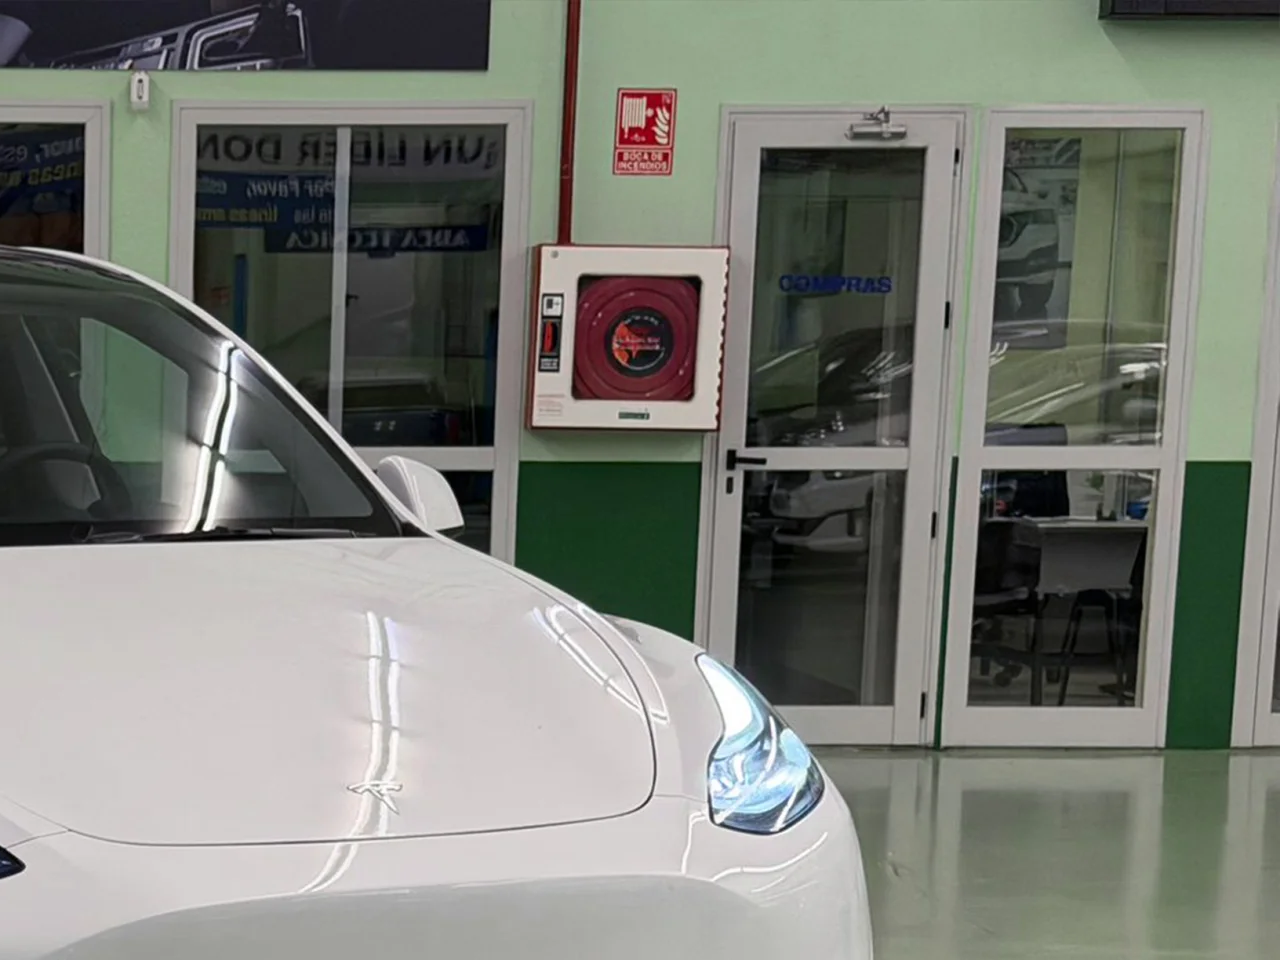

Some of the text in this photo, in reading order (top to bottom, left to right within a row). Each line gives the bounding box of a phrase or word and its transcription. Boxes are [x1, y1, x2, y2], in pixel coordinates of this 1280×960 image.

[623, 151, 649, 161] BOCA
[617, 161, 667, 172] INCENDIOS
[779, 275, 892, 294] COMPRAS
